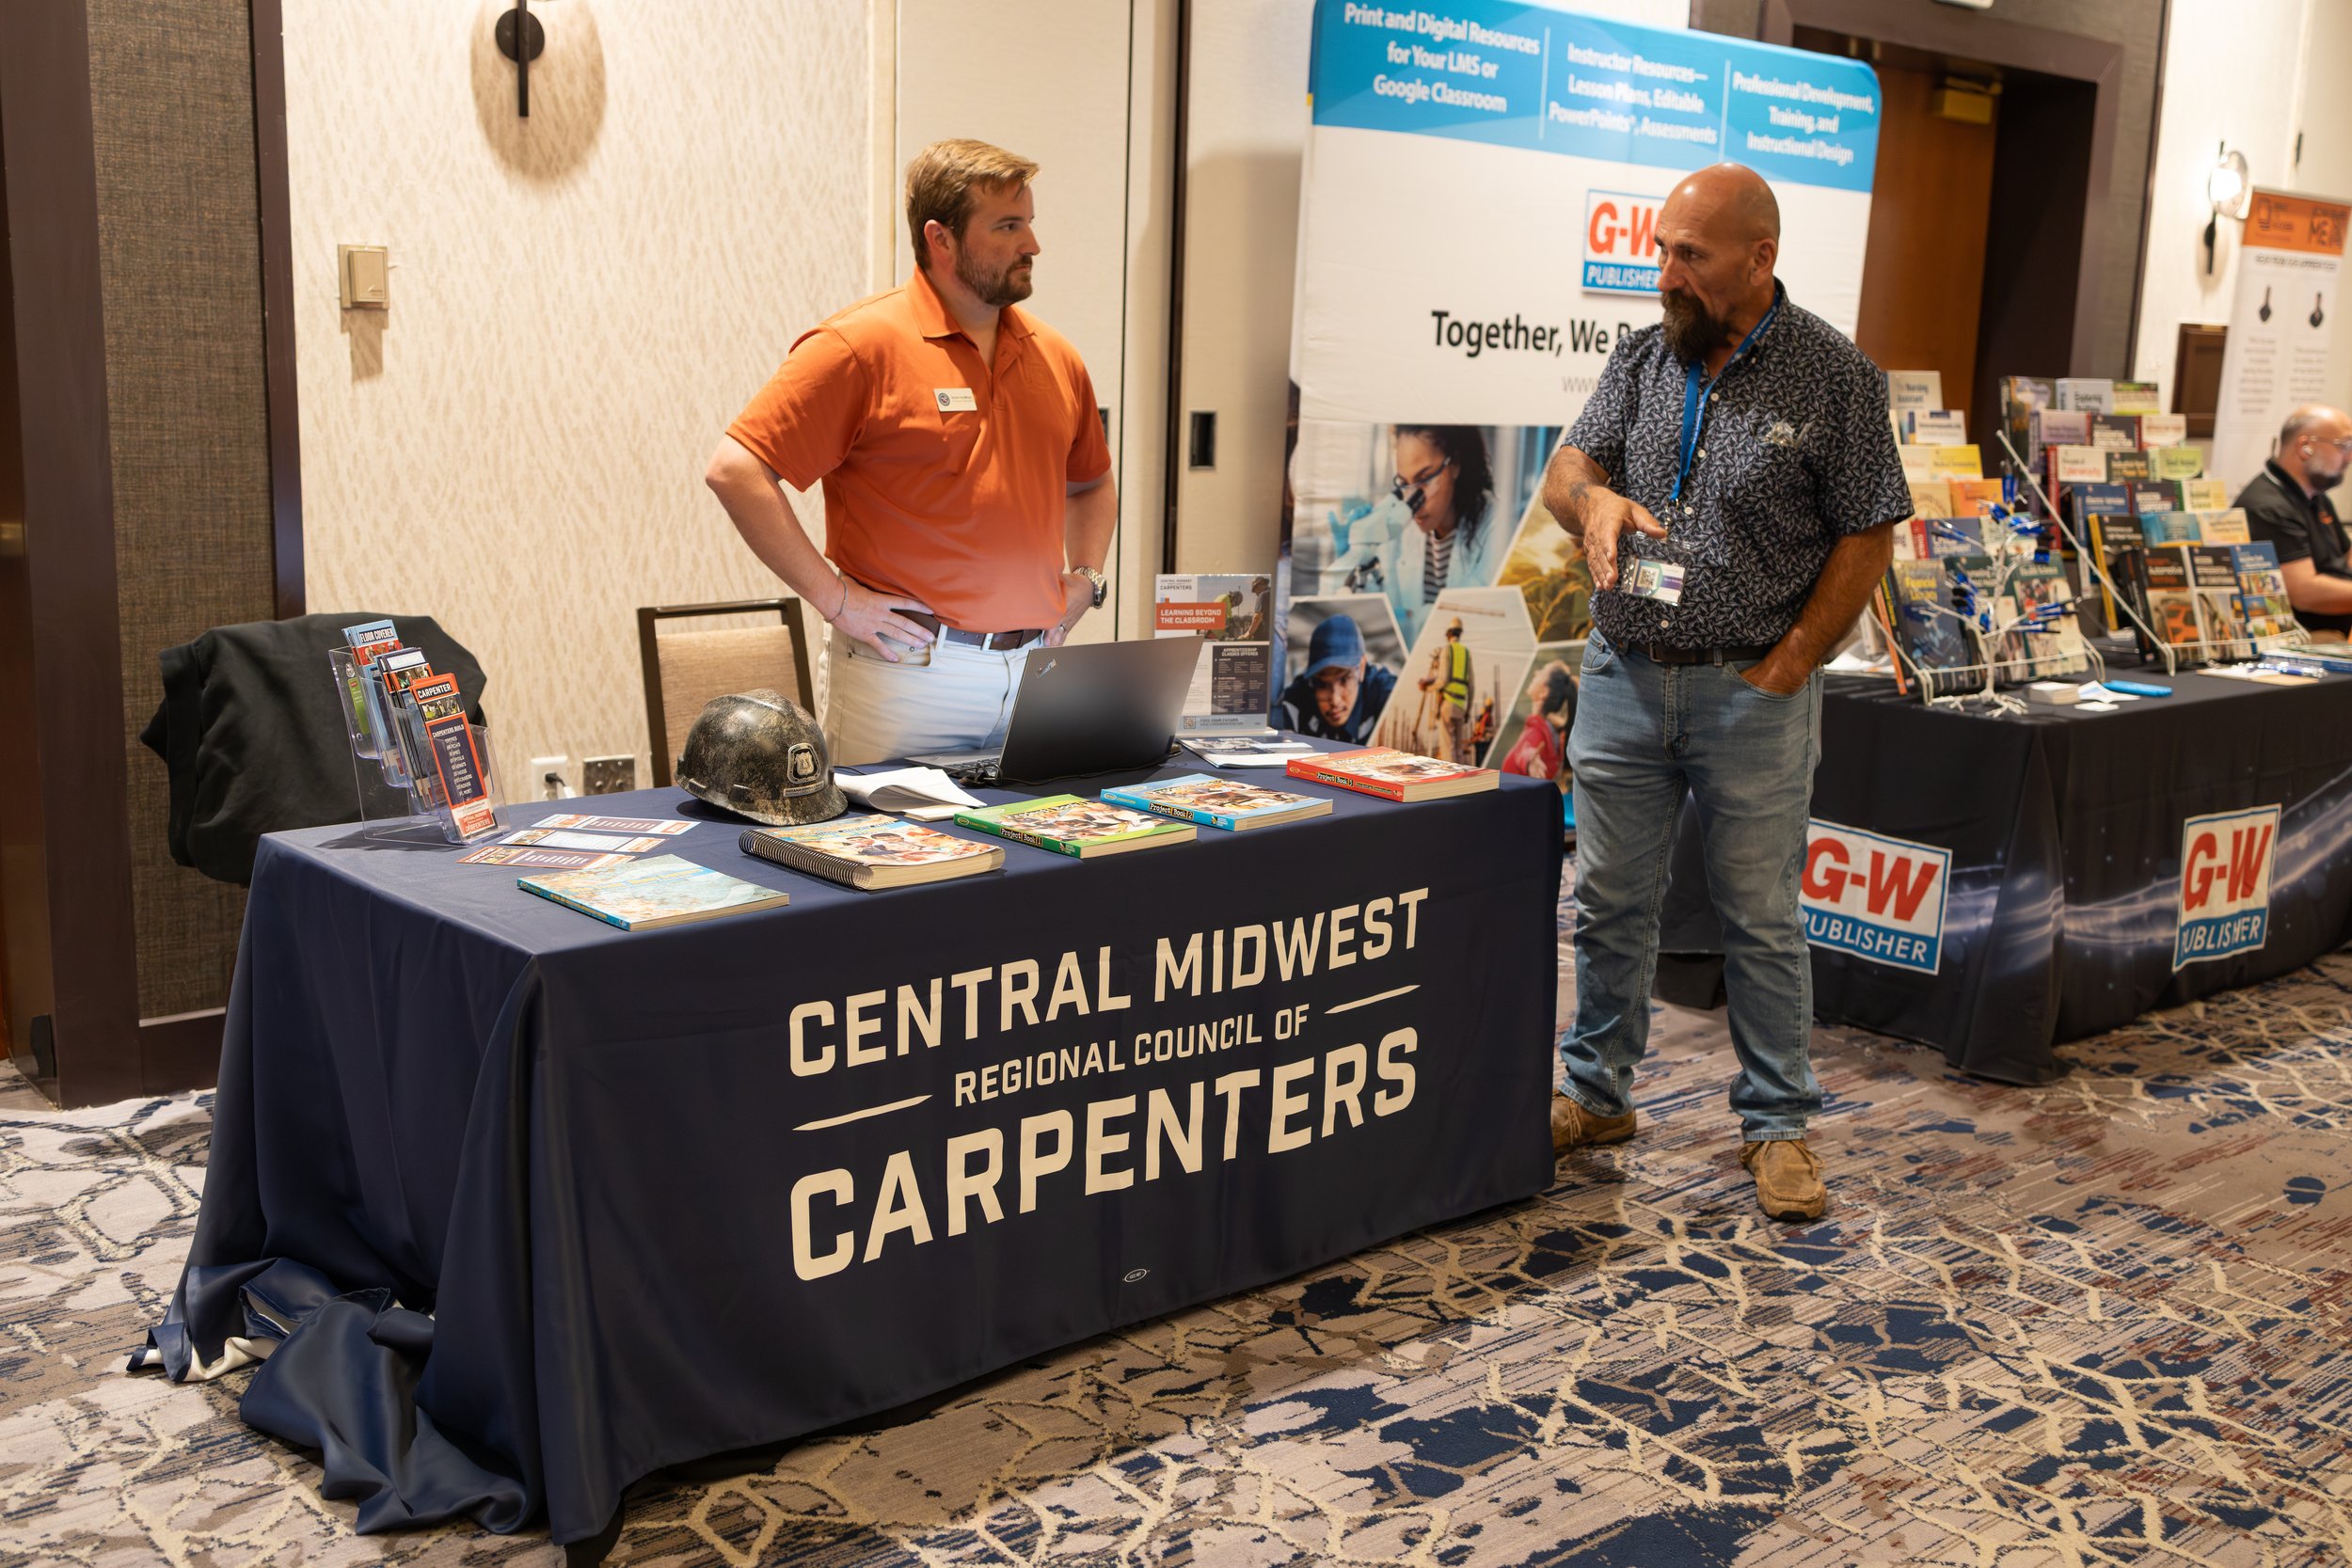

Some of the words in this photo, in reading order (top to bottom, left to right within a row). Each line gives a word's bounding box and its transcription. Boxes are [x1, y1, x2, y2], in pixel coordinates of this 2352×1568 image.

[1344, 2, 1384, 27] Print
[1385, 10, 1415, 31] and
[1417, 12, 1468, 42] Digital
[1469, 22, 1540, 55] Resources
[1387, 40, 1410, 65] for
[1412, 44, 1447, 71] Your
[1448, 51, 1480, 76] LMS
[1482, 60, 1499, 79] or
[1567, 42, 1631, 72] Instructor
[1374, 74, 1430, 104] Google
[1432, 82, 1507, 113] Classroom
[1568, 73, 1613, 100] Lesson
[1614, 82, 1652, 108] Plans,
[1653, 88, 1705, 114] Editable
[1732, 71, 1801, 101] Professional
[1801, 82, 1875, 115] Development,
[1641, 116, 1718, 145] Assessments
[1769, 104, 1817, 135] Training,
[1817, 114, 1839, 135] and
[1746, 131, 1816, 158] Instructional
[1815, 139, 1854, 166] Design
[1589, 201, 1664, 258] G-W
[1587, 265, 1661, 291] PUBLISHE
[1431, 309, 1563, 357] Together,
[1570, 317, 1609, 355] We
[359, 629, 374, 643] FLOOR
[374, 626, 394, 641] COVERER
[417, 682, 453, 700] CARPENTER
[432, 726, 454, 738] CARPENTERS
[454, 723, 465, 732] BUILD
[1317, 772, 1335, 783] Project
[1336, 776, 1348, 785] Book
[1150, 802, 1171, 815] Project
[1173, 808, 1187, 818] Book
[1001, 828, 1022, 840] Project
[1023, 833, 1037, 844] Book
[1038, 837, 1042, 846] 1
[1801, 837, 1940, 922] G-W
[2184, 823, 2274, 912] G-W
[788, 944, 1131, 1078] CENTRAL
[1153, 887, 1429, 1003] MIDWEST
[954, 1039, 1125, 1107] REGIONAL
[1134, 1013, 1263, 1066] COUNCIL
[1274, 1004, 1310, 1040] OF
[789, 1026, 1419, 1281] CARPENTERS
